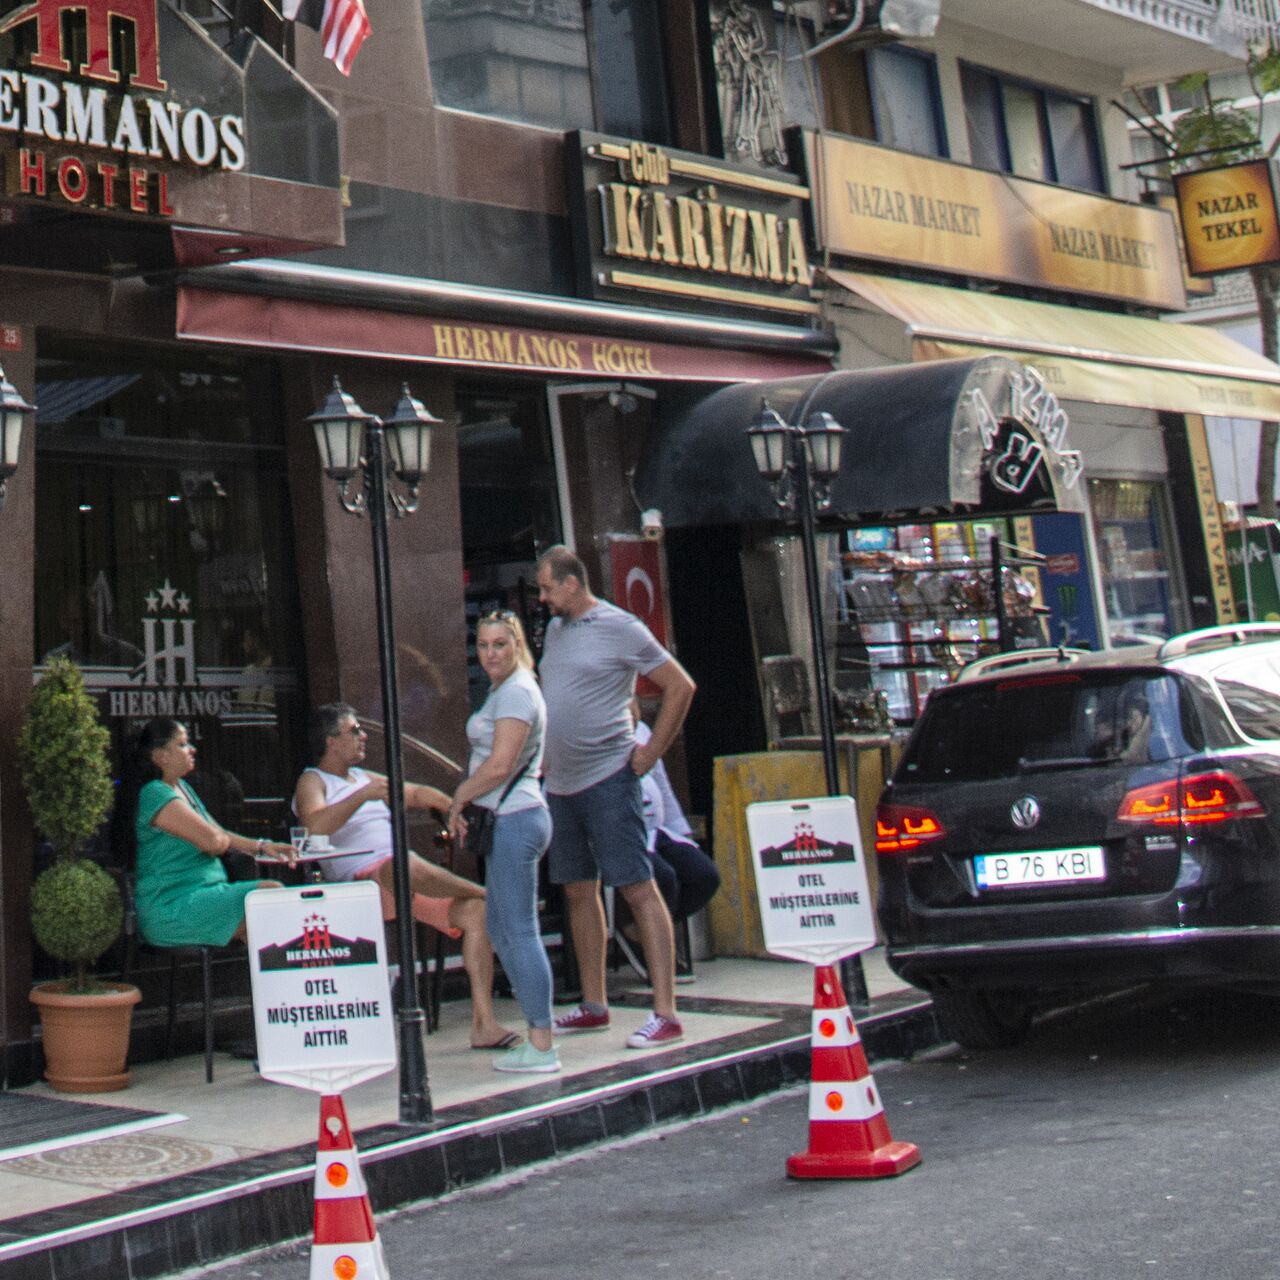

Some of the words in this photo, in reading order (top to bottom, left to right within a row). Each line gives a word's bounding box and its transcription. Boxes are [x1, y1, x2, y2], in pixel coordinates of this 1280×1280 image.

[20, 148, 174, 216] HOTEL
[846, 181, 907, 226] NAZAR
[908, 191, 981, 239] MARKET
[1197, 192, 1260, 219] NAZAR
[1201, 219, 1263, 243] TEKEL
[1047, 222, 1100, 262] NAZAR
[1100, 231, 1159, 272] MARKET
[432, 324, 579, 370] HERMANOS
[591, 341, 662, 374] HOTEL
[110, 691, 233, 717] HERMANOS
[995, 858, 1010, 880] B
[1021, 855, 1045, 879] 76
[1056, 852, 1093, 877] KBI
[798, 873, 826, 888] OTEL
[285, 947, 352, 962] HERMANOS
[304, 978, 338, 996] OTEL
[267, 997, 381, 1028] MÜŞTERİLERİNE
[303, 1024, 349, 1048] AİTTİR
